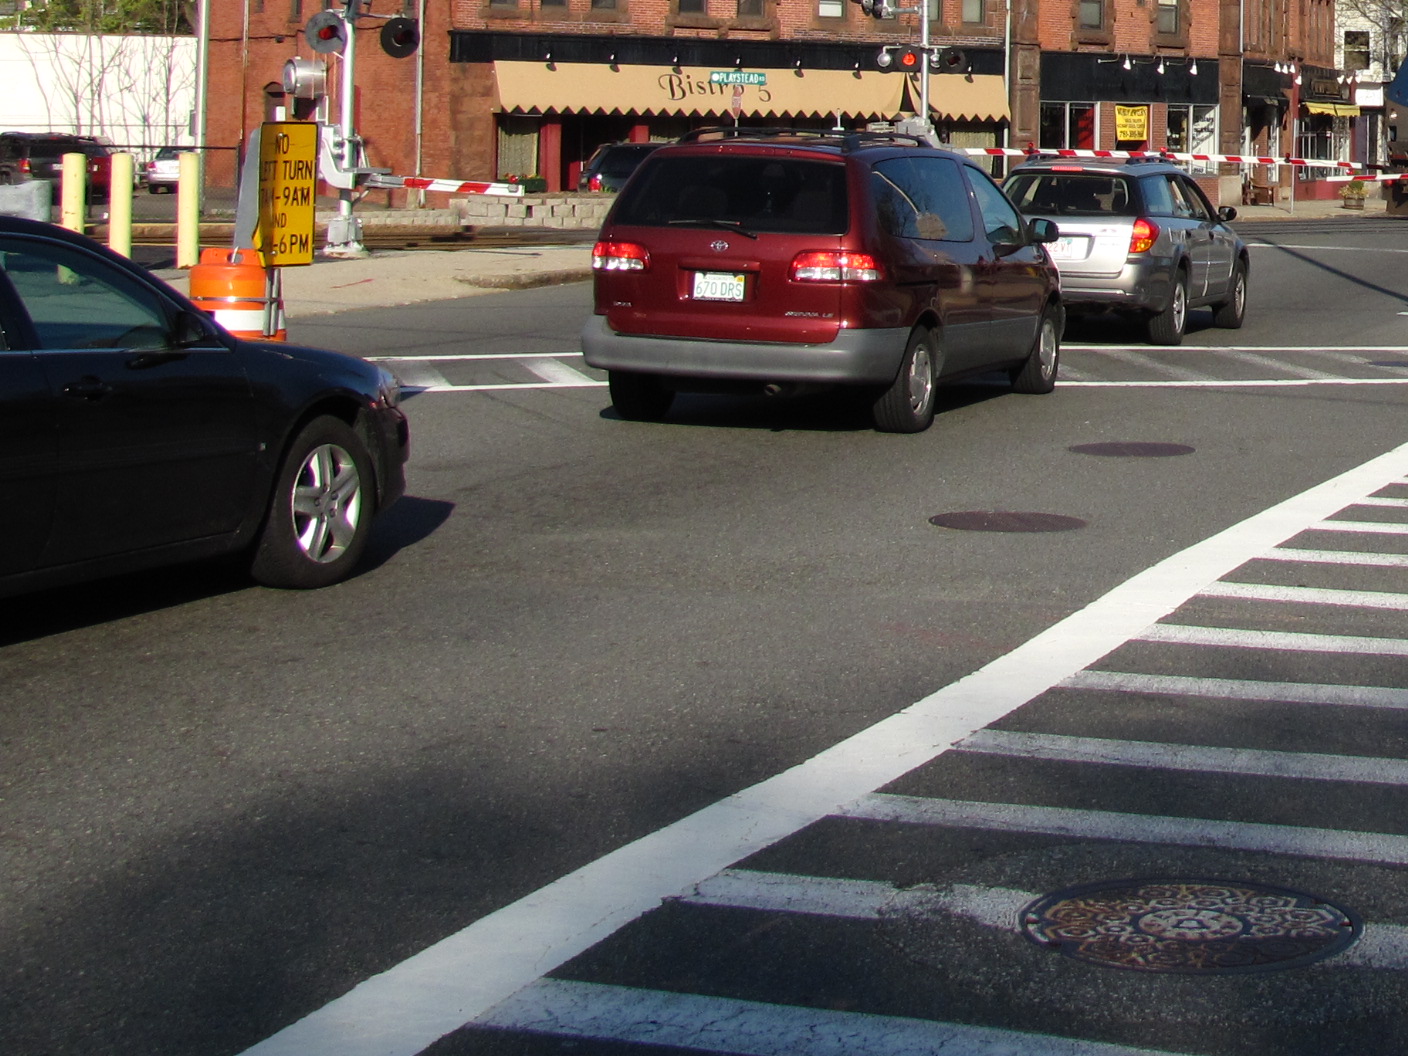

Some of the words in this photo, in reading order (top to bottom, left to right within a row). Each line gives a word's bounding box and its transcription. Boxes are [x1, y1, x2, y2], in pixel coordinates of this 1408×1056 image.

[719, 72, 759, 83] PLAYSTEAD
[275, 134, 290, 155] NO
[283, 159, 313, 181] TURN
[273, 212, 287, 228] ND
[696, 281, 717, 295] 670
[720, 282, 742, 297] DRS
